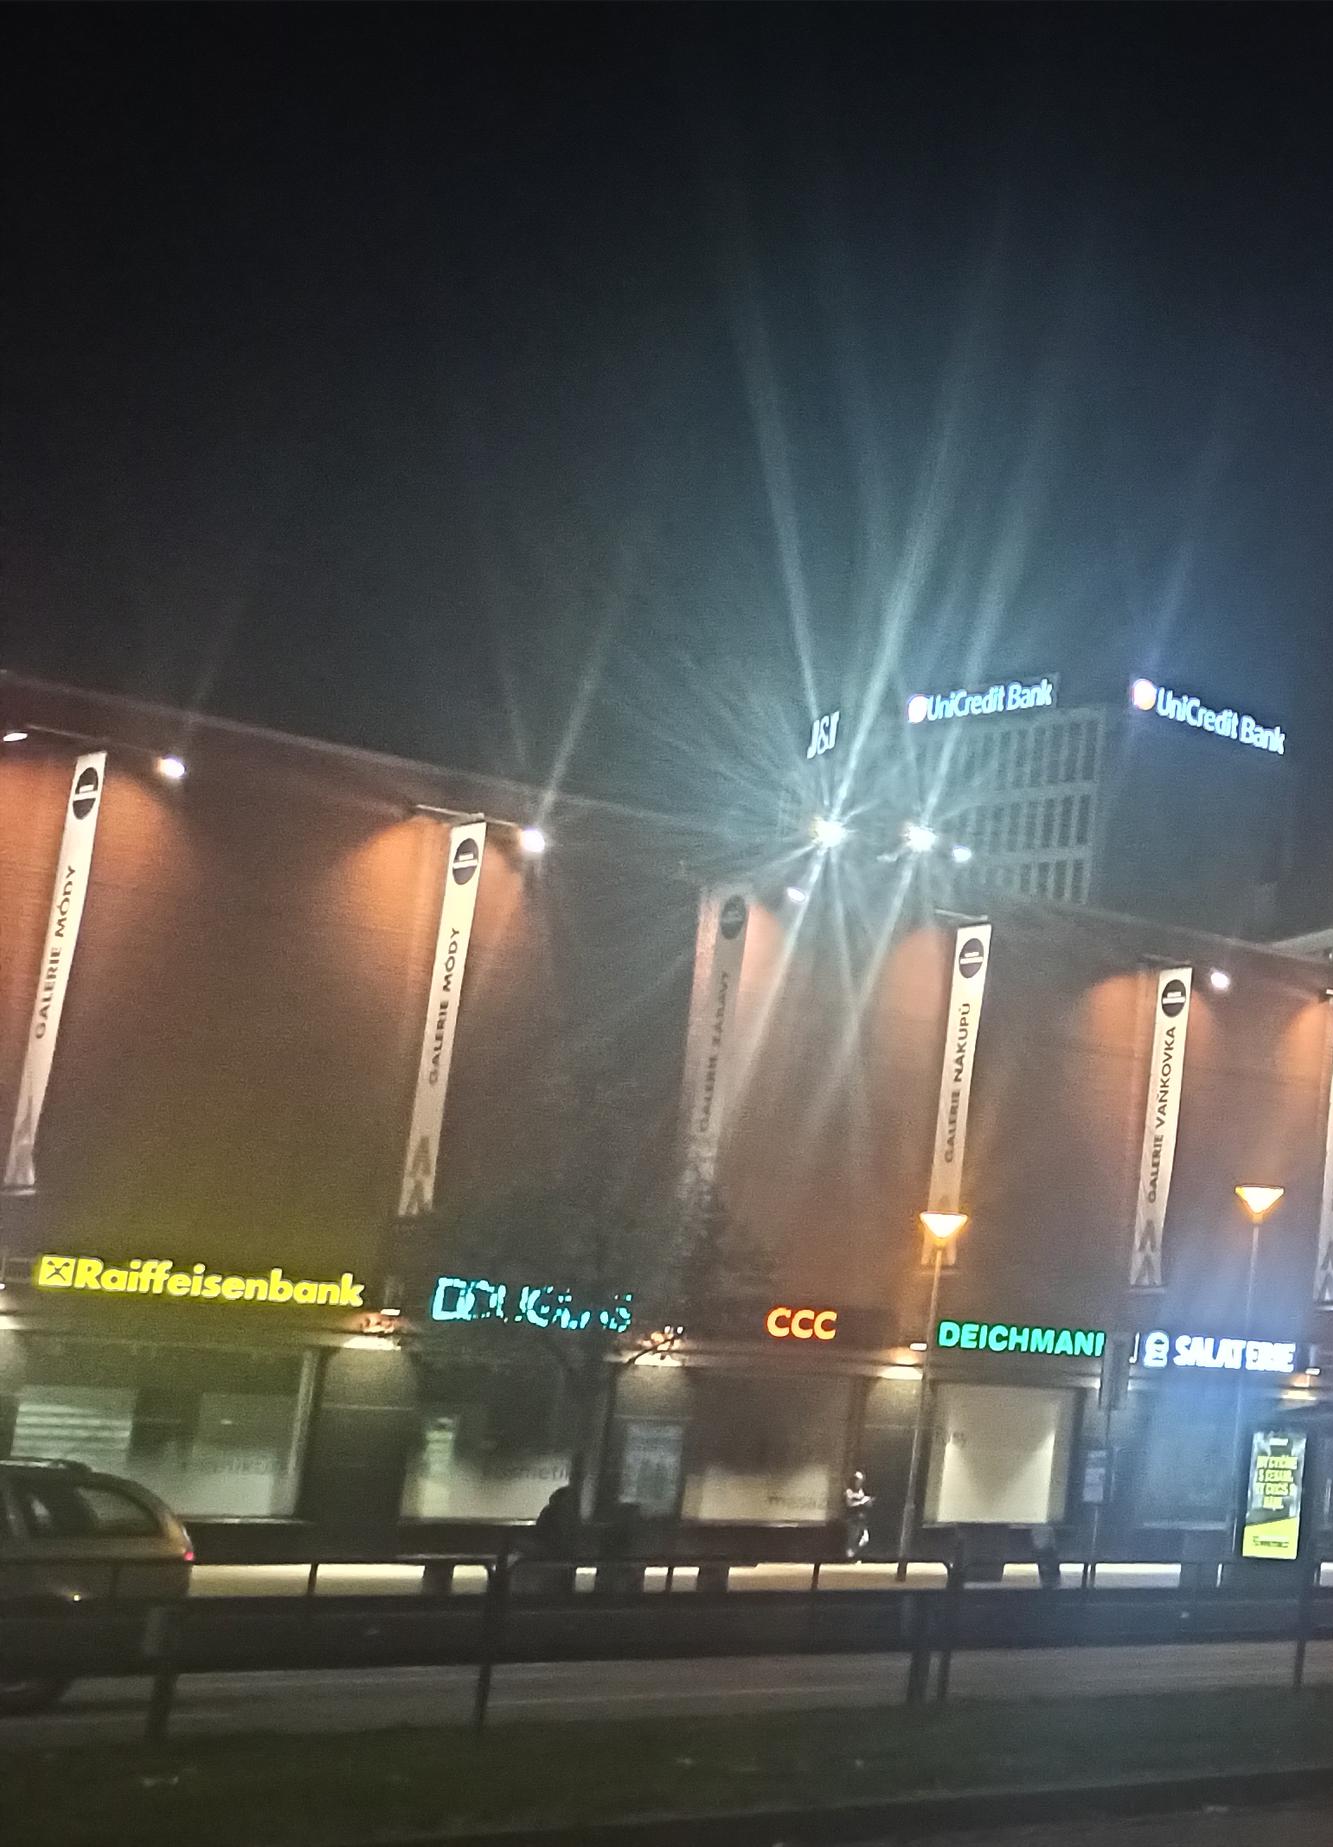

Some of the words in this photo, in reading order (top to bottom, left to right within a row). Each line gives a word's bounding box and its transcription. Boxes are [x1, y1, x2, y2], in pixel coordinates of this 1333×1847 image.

[927, 685, 1005, 720] UniCredit
[1006, 679, 1052, 711] Bank
[1156, 687, 1239, 739] UniCredit
[1240, 715, 1285, 755] Bank
[35, 946, 62, 1040] GALERIE
[54, 865, 76, 938] MÓDY
[429, 1000, 449, 1086] GALERIE
[443, 927, 459, 993] MÓDY
[1155, 1026, 1176, 1128] VAŇKOVKA
[945, 1090, 960, 1164] GALERIE
[1148, 1134, 1163, 1204] GALERIE
[74, 1257, 365, 1307] Raiffeisenbank
[767, 1307, 838, 1340] CCC
